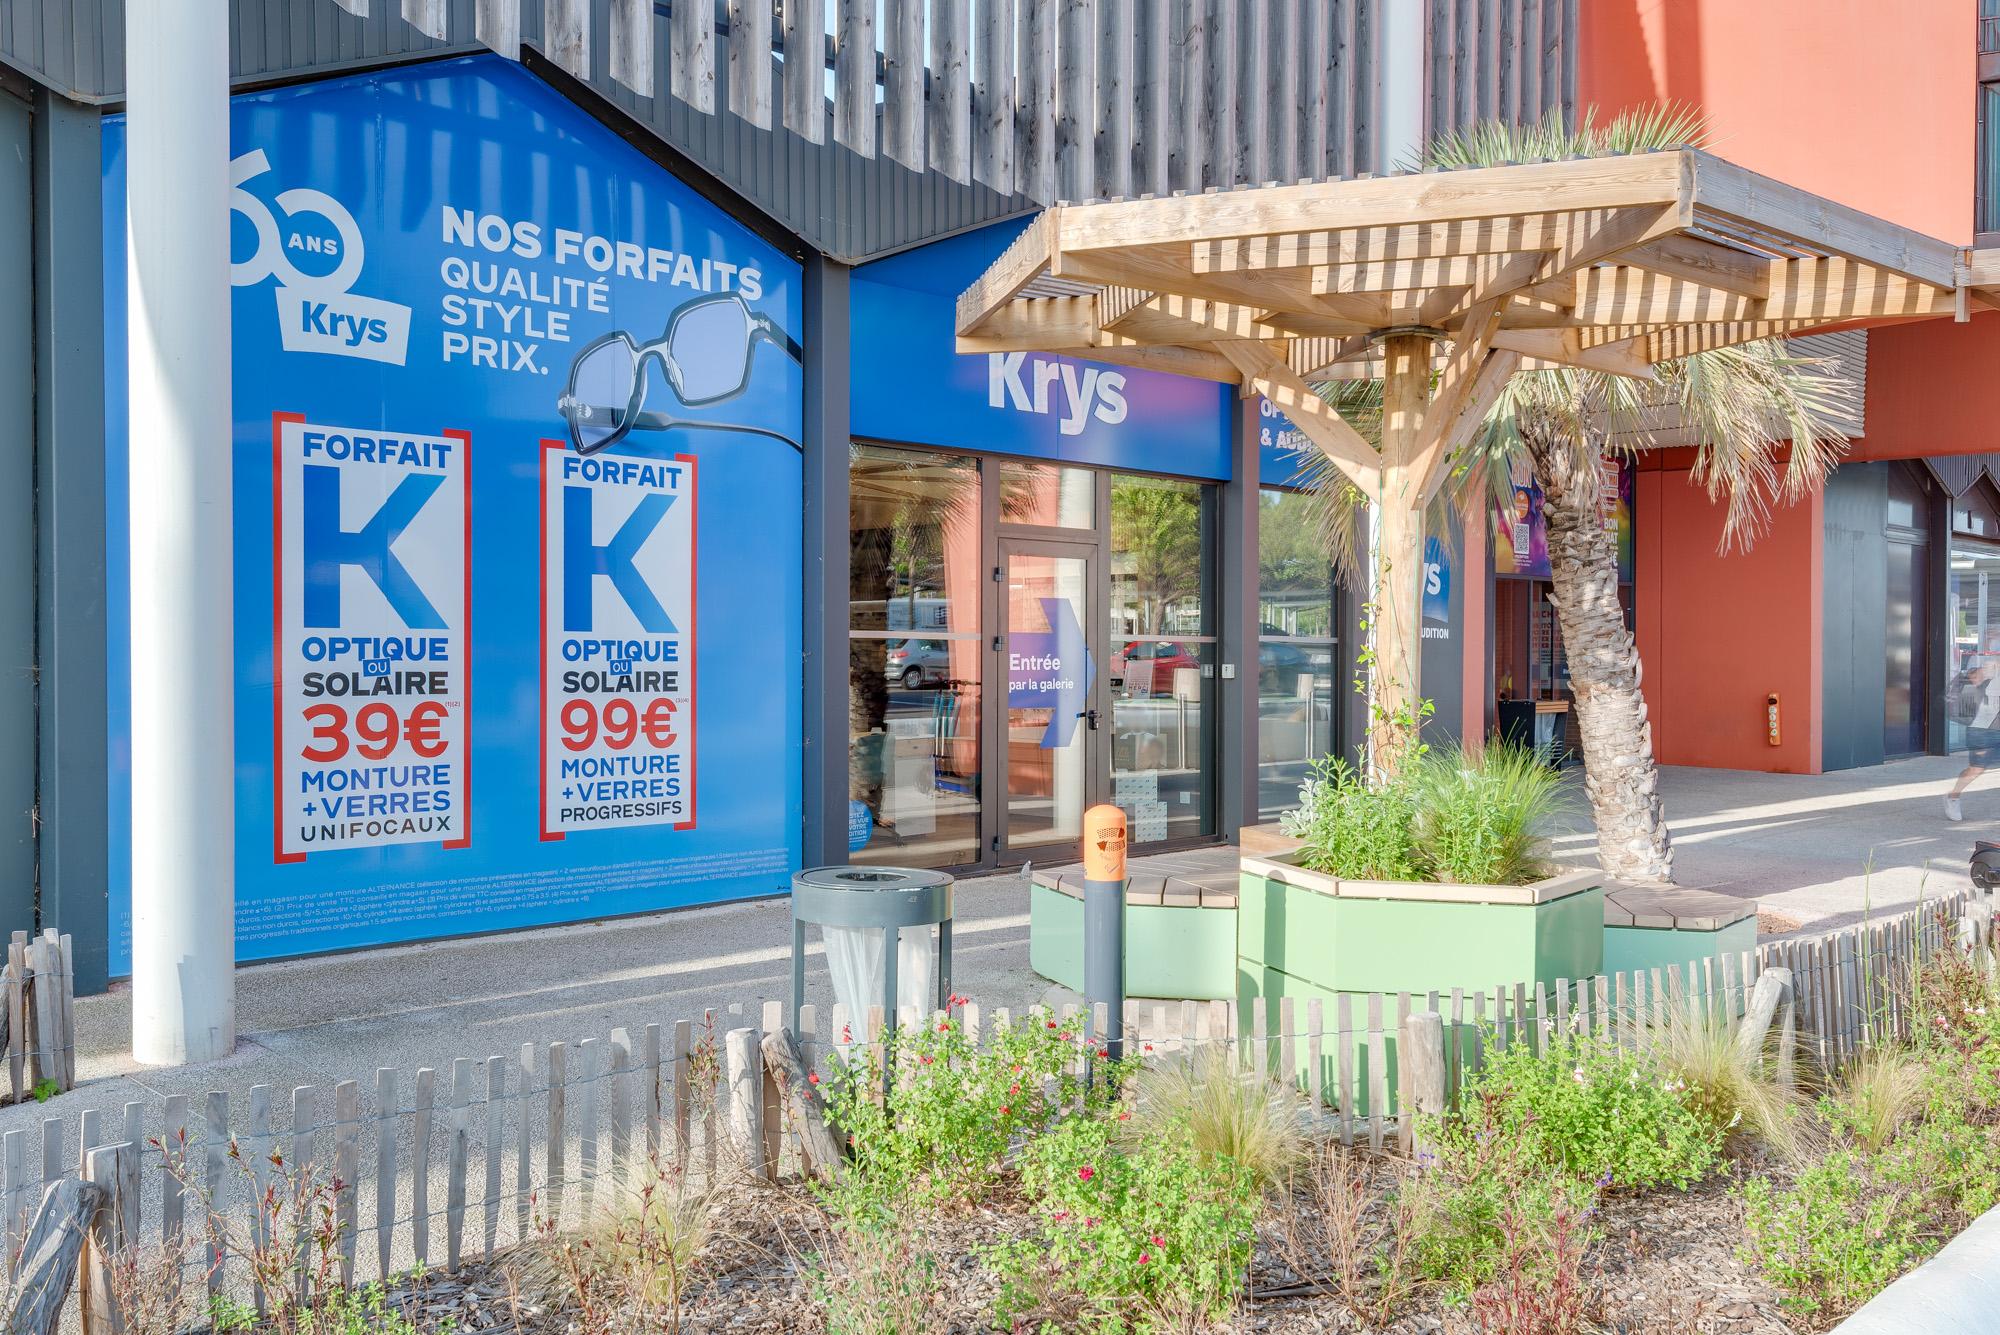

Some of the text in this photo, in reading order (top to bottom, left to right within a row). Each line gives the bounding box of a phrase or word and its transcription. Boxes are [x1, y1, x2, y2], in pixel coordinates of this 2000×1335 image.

[288, 233, 338, 255] ANS
[442, 206, 762, 301] NOS FORFAITS
[441, 257, 610, 314] QUALITÉ
[301, 302, 388, 345] Krys
[441, 295, 570, 343] STYLE
[442, 332, 549, 376] PRIX.
[989, 351, 1128, 436] Krys
[302, 432, 452, 469] FORFAIT
[1261, 428, 1272, 446] &
[562, 456, 682, 489] FORFAIT
[1604, 518, 1618, 530] BON
[303, 464, 450, 630] K
[563, 485, 680, 634] K
[1421, 627, 1449, 639] UDITION
[302, 636, 449, 662] OPTIQUE
[562, 639, 679, 663] OPTIQUE
[1009, 653, 1061, 671] Entrée
[367, 661, 389, 675] OU
[612, 661, 630, 673] OU
[302, 671, 449, 698] SOLAIRE
[562, 671, 679, 693] SOLAIRE
[1009, 677, 1074, 693] par la galerie
[302, 701, 449, 763] 39€
[561, 698, 678, 752] 99€
[302, 764, 451, 794] MONTURE
[562, 754, 681, 780] MONTURE
[561, 799, 682, 823] PROGRESSIFS
[301, 815, 451, 843] UNIFOCAUX
